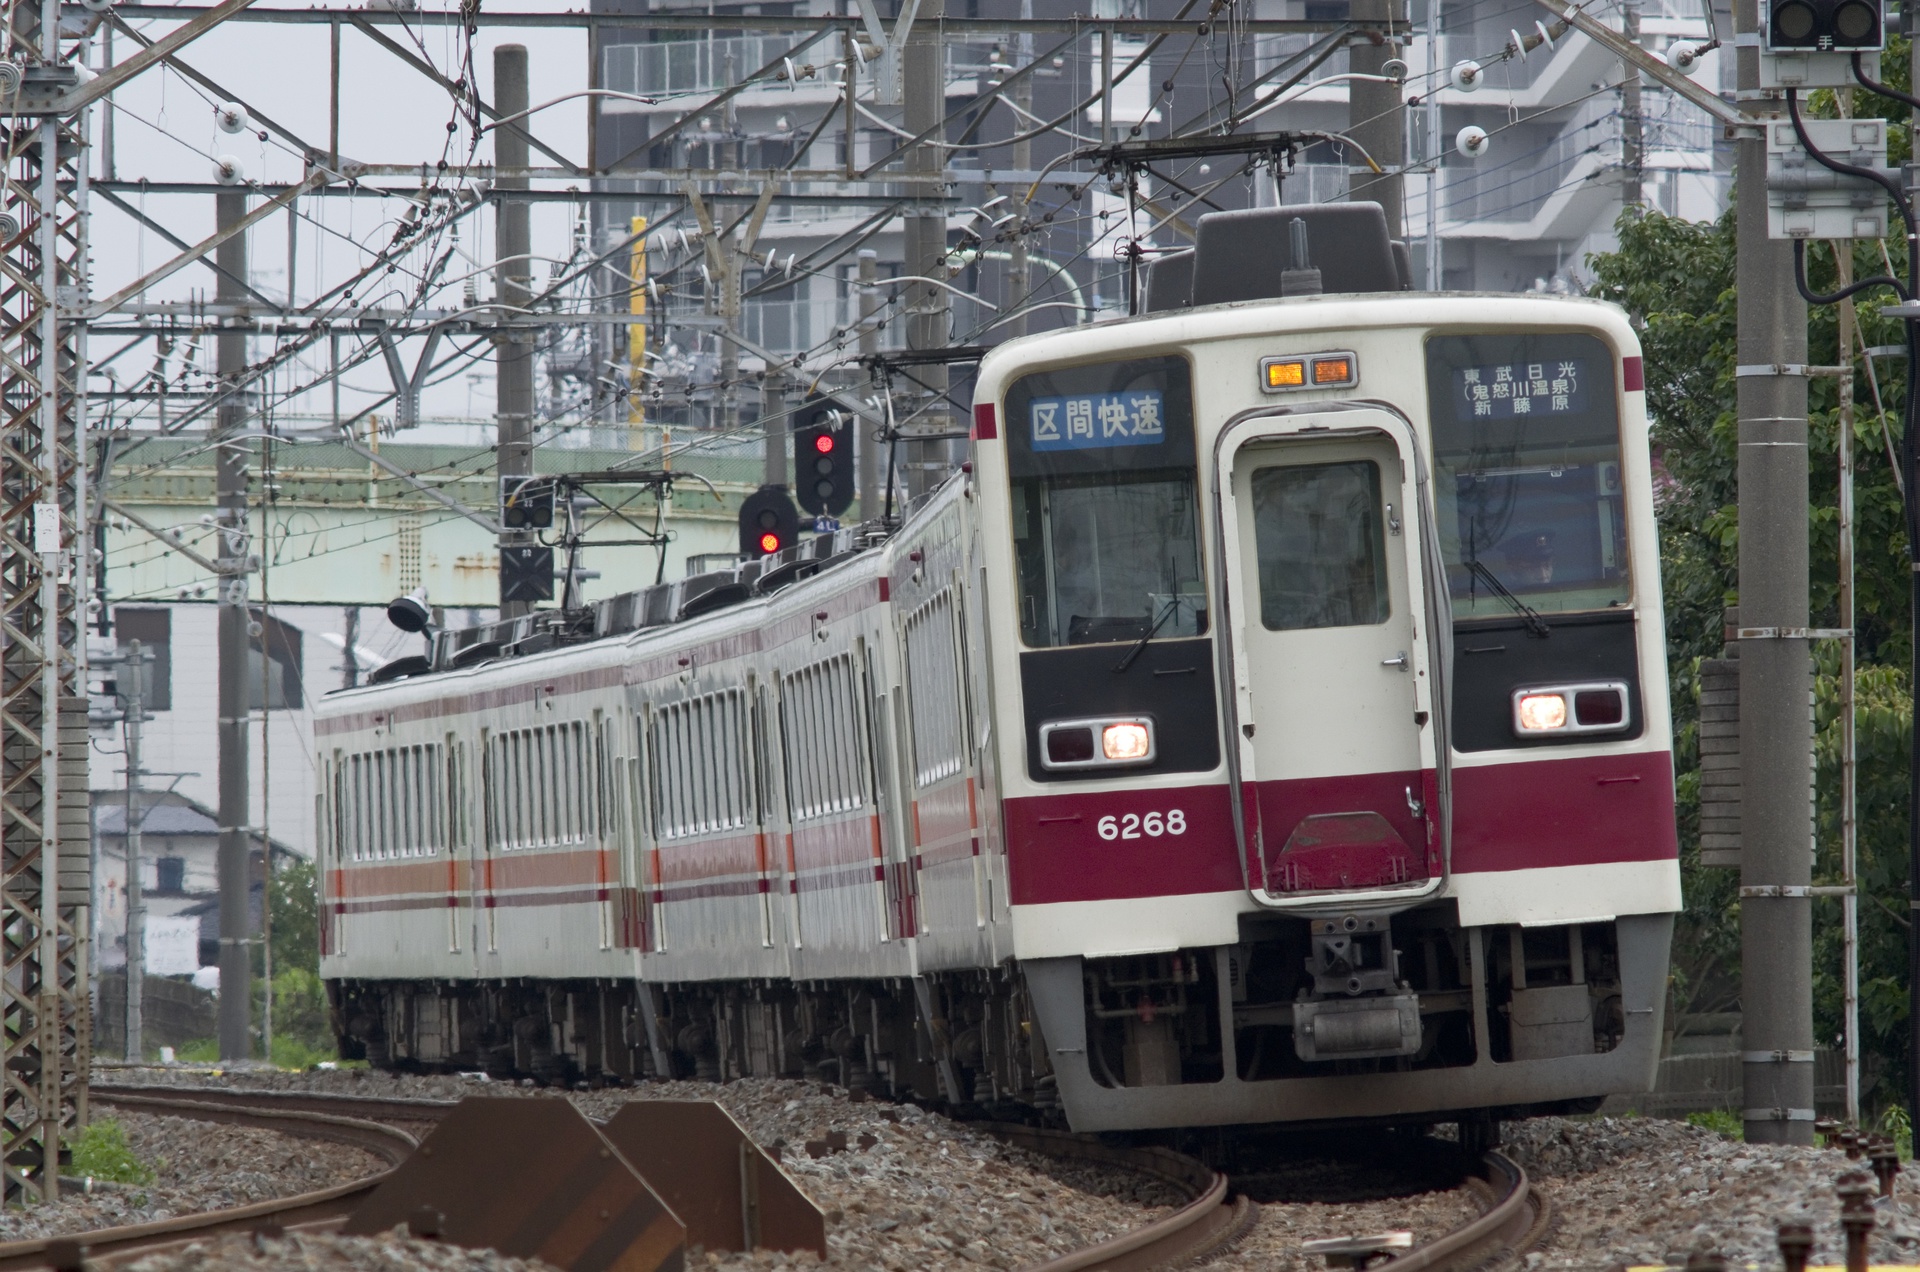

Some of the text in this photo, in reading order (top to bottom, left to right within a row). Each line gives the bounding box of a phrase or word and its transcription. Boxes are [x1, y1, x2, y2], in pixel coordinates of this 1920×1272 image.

[1818, 35, 1833, 50] 手
[1463, 361, 1576, 385] 東武日光
[1464, 377, 1577, 401] (鬼怒川温泉)
[1474, 394, 1569, 416] 新藤原
[1032, 394, 1163, 442] 区間快速
[1097, 809, 1187, 841] 6268
